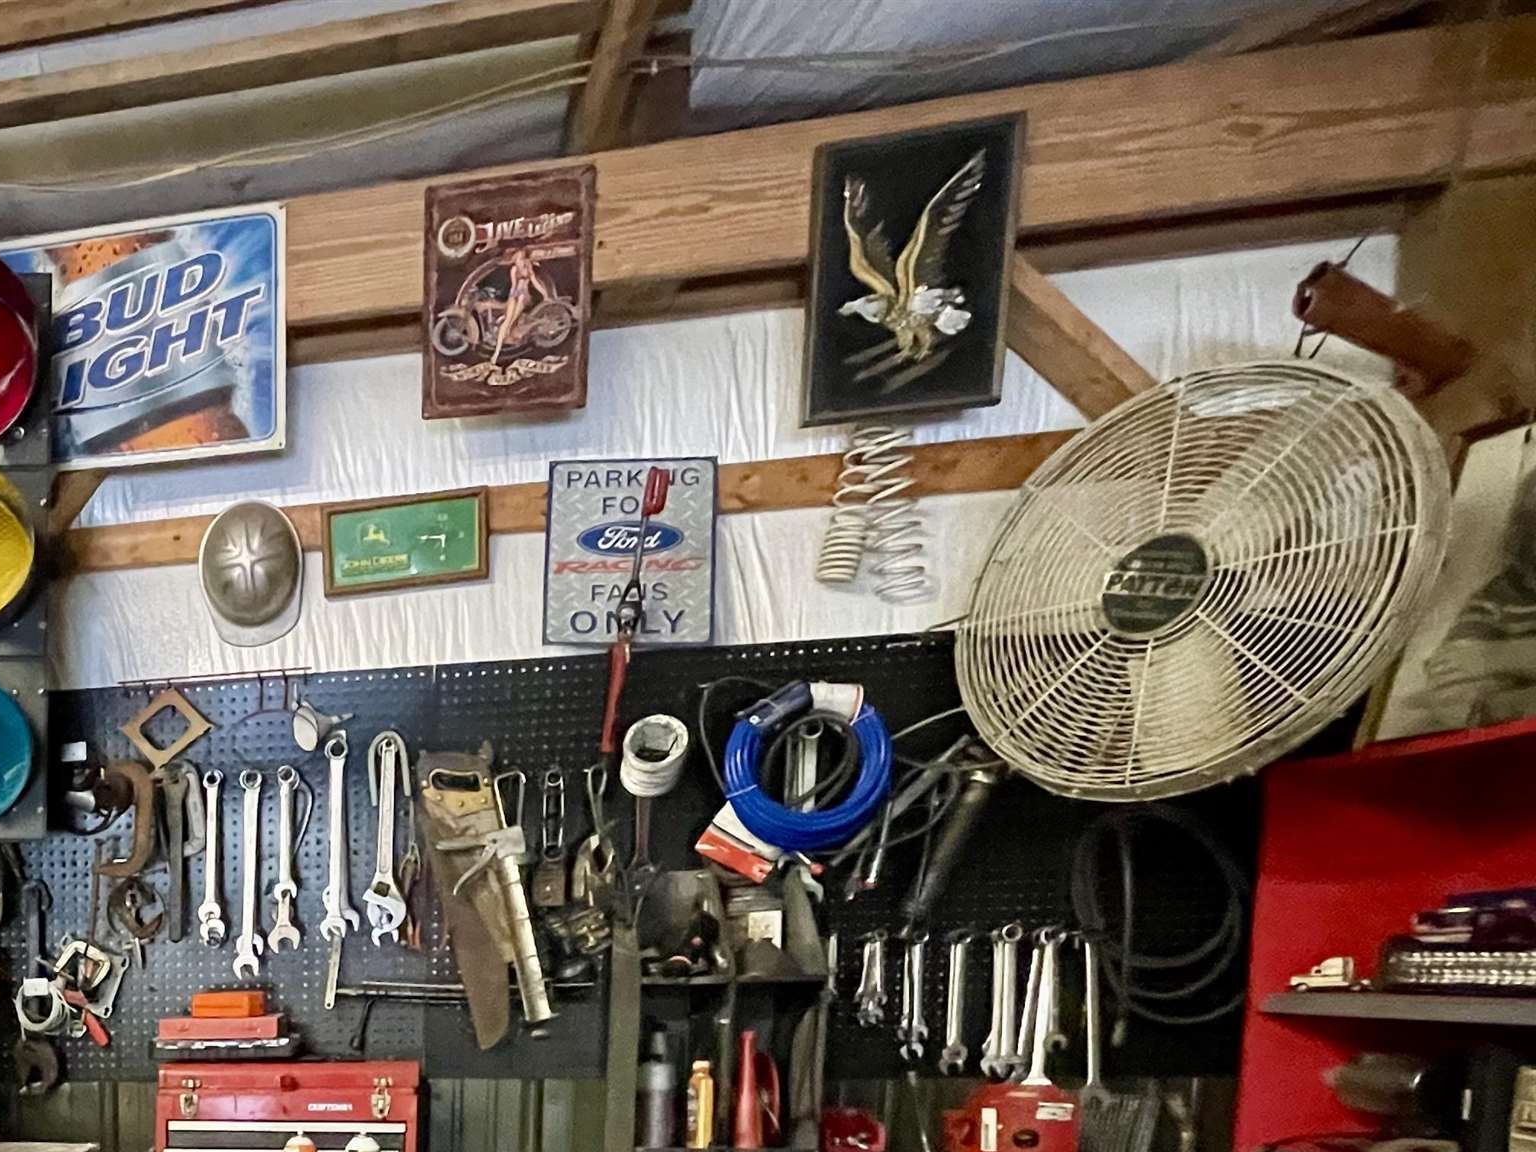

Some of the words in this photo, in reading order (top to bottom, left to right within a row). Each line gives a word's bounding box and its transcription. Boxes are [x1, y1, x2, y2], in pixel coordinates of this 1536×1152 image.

[57, 252, 223, 351] BUD
[61, 284, 263, 408] IGHT
[566, 467, 700, 489] PARKNG
[602, 496, 640, 515] FO
[597, 526, 662, 549] Ford
[553, 557, 705, 575] RACNG
